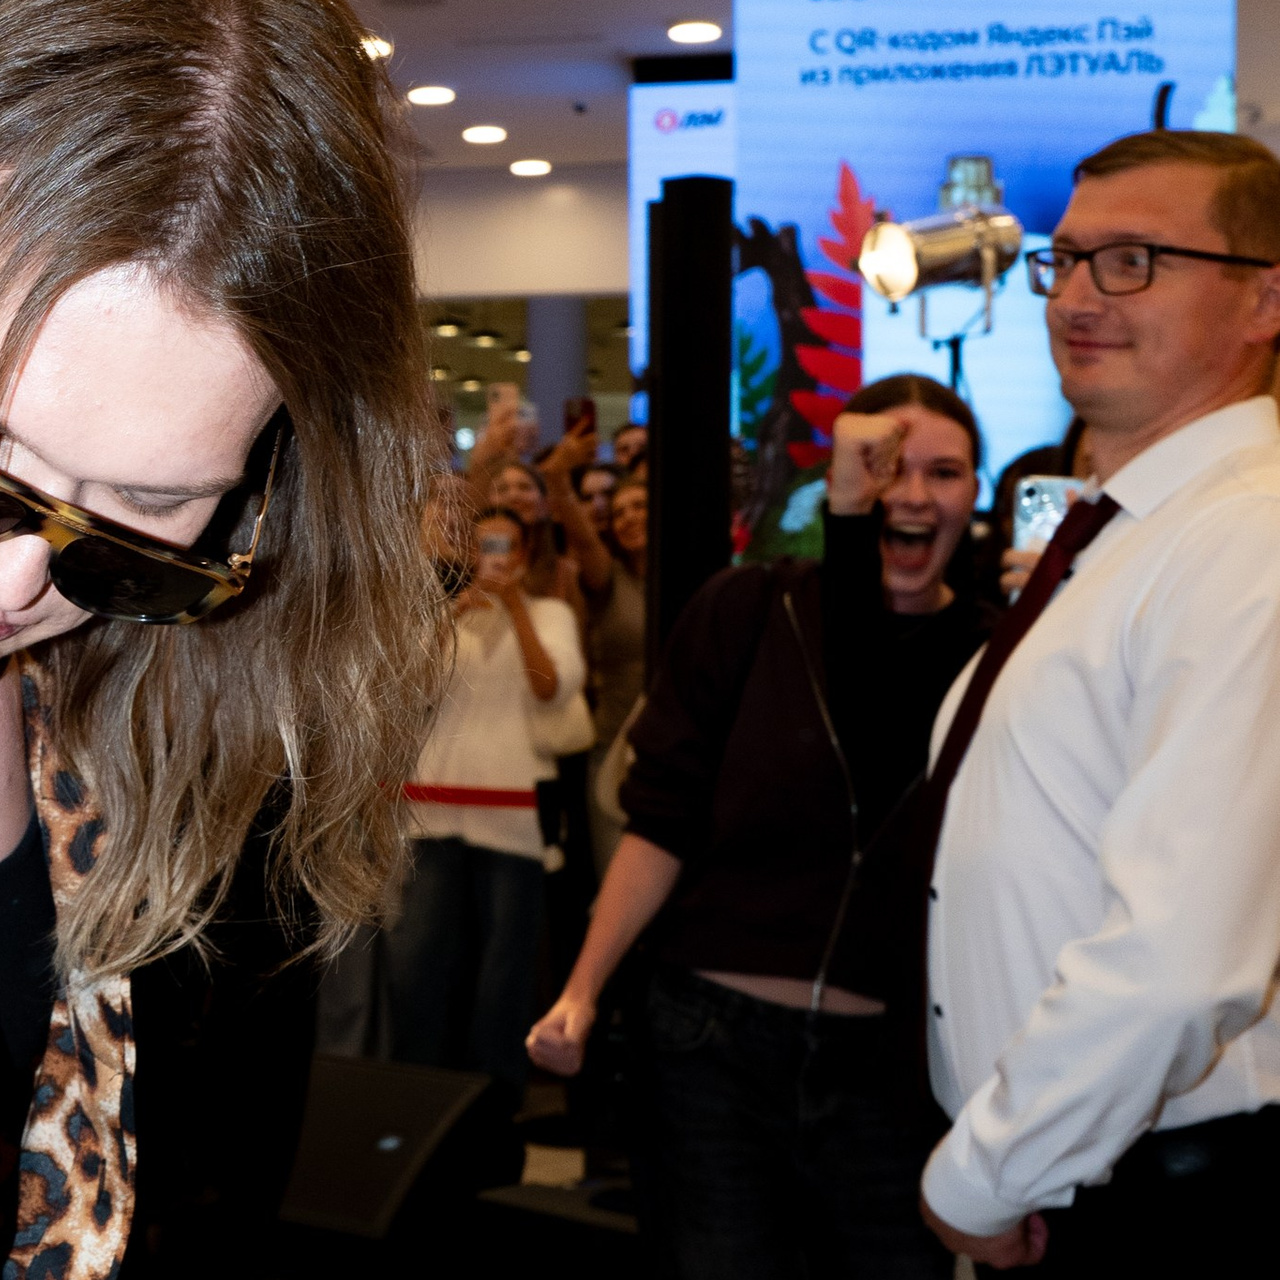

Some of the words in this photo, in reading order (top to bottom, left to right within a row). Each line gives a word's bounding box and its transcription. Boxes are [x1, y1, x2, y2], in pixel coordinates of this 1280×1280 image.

[986, 23, 1088, 46] Яндекс
[800, 69, 831, 86] из
[837, 61, 1018, 87] приложения
[1024, 50, 1165, 77] ЛЭТУАЛЬ
